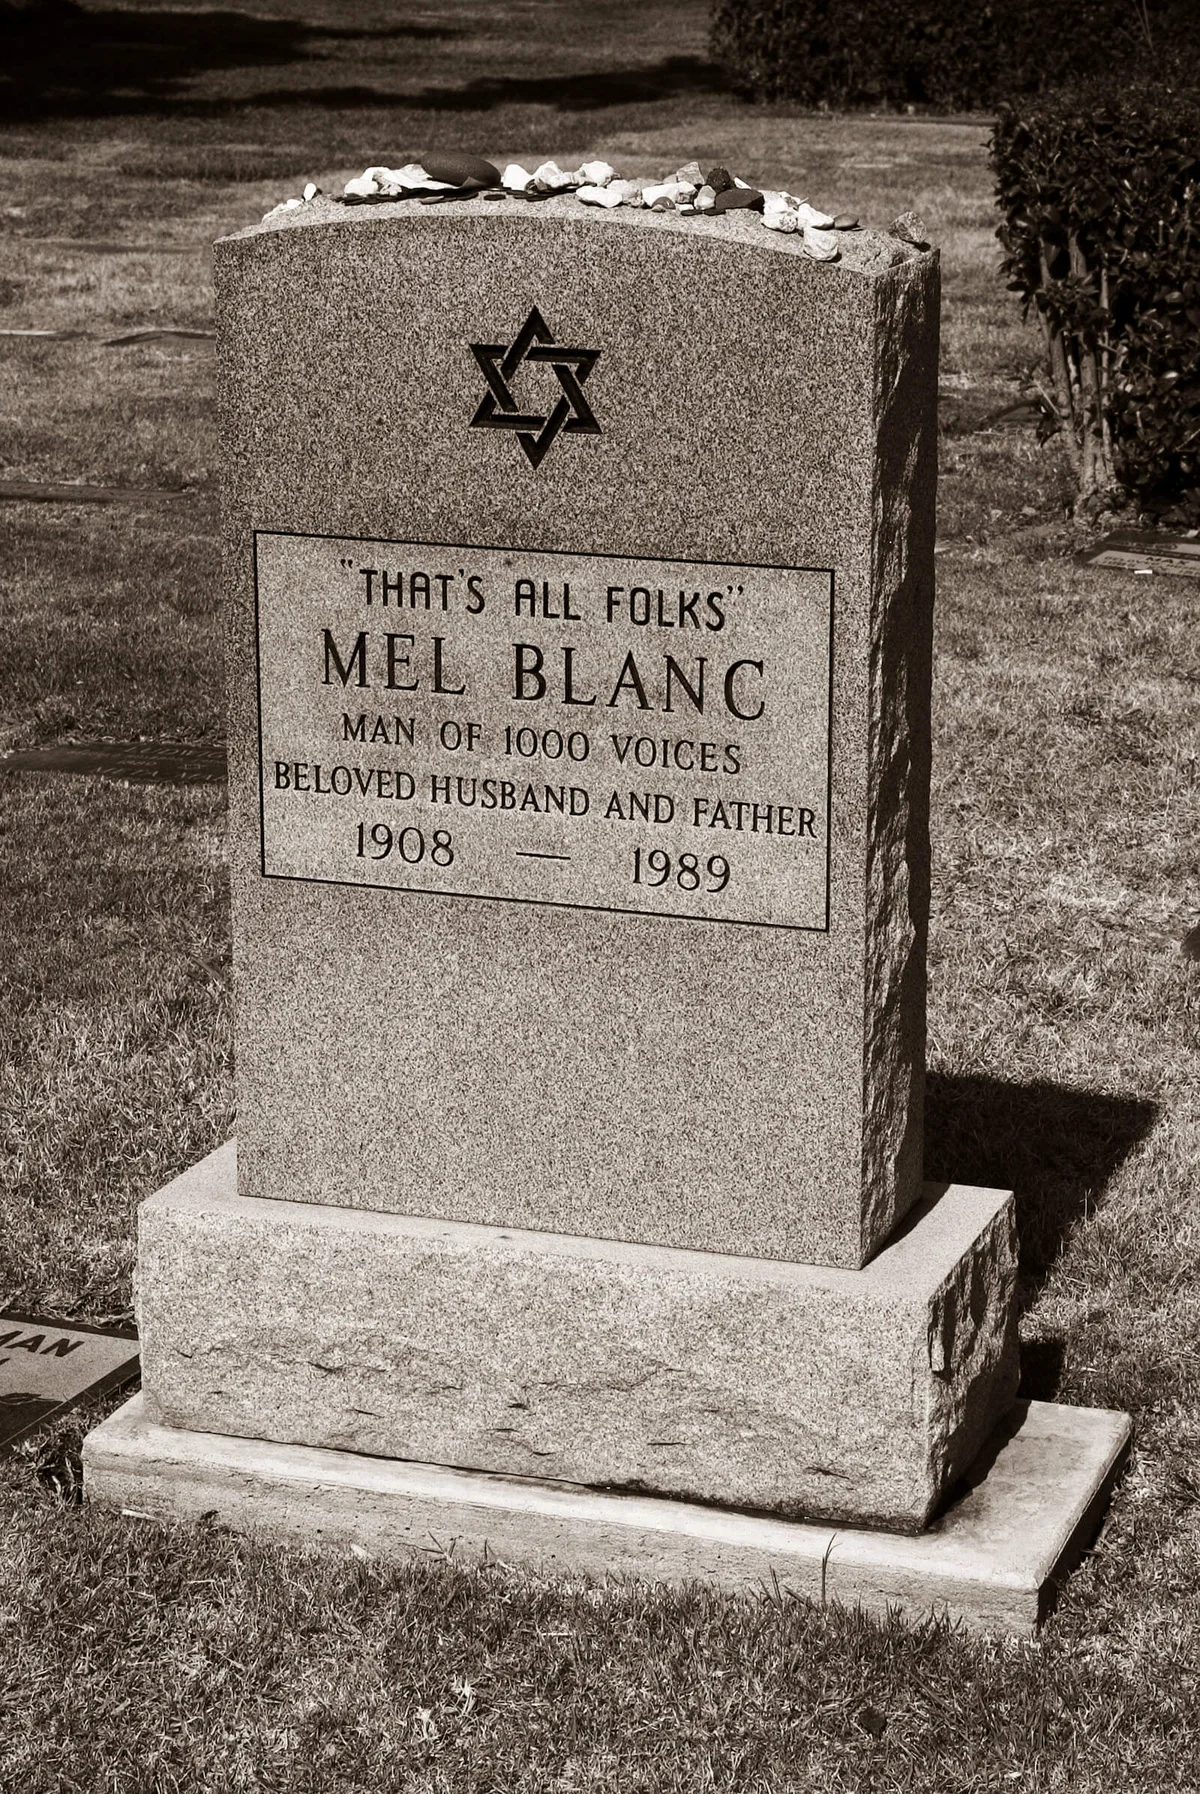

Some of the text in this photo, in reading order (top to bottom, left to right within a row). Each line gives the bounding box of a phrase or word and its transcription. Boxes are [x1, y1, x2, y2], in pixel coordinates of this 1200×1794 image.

[340, 559, 743, 631] "THAT'S ALL FOLKS"
[321, 629, 766, 720] MEL BLANC
[342, 713, 742, 774] MAN OF 1000 VOICES
[274, 762, 818, 838] BELOVED HUSBAND AND FATHER
[356, 822, 454, 867] 1908
[632, 847, 730, 893] 1989
